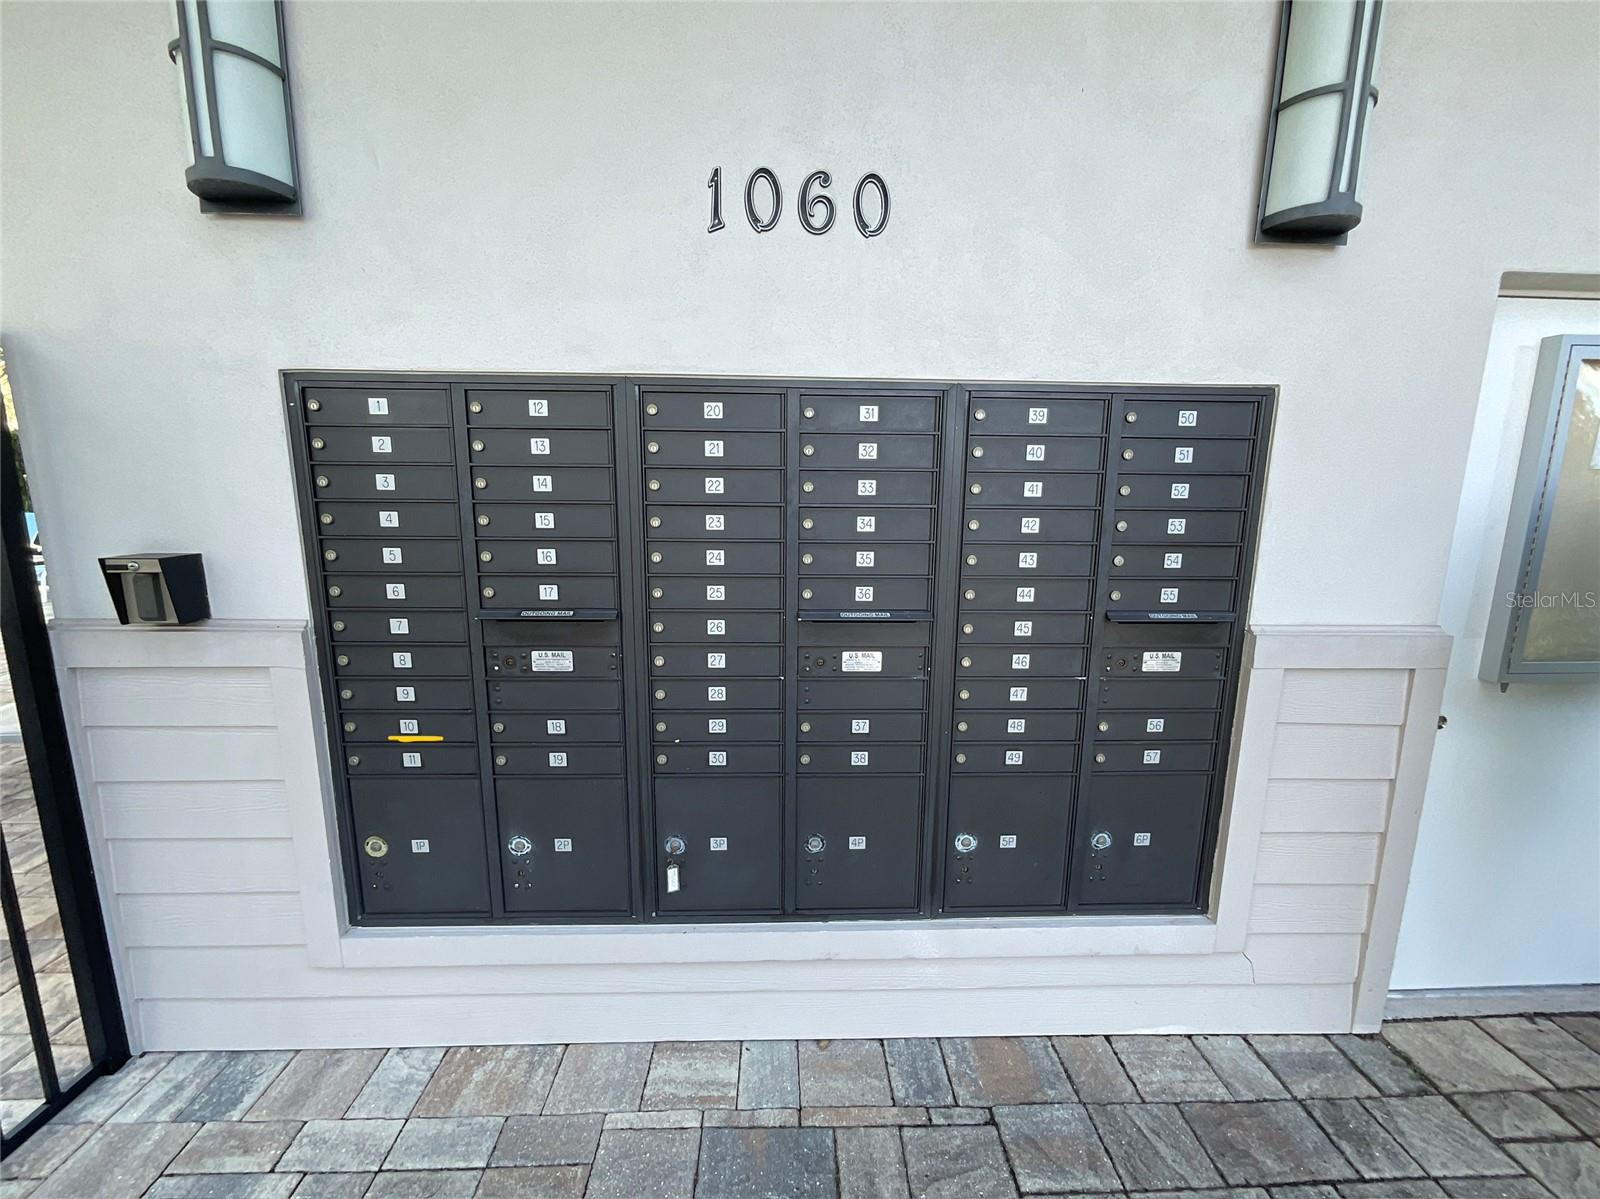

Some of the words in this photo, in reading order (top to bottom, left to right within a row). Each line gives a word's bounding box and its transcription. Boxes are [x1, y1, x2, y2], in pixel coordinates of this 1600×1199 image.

[708, 166, 891, 238] 1060
[533, 401, 544, 415] 12
[706, 404, 721, 417] 20
[863, 407, 875, 420] 31
[1031, 409, 1045, 422] 39
[1180, 412, 1195, 425] 50
[535, 440, 546, 453] 13
[709, 442, 720, 455] 21
[860, 444, 875, 458] 32
[1028, 446, 1043, 459] 40
[1178, 449, 1190, 462] 51
[537, 477, 548, 489] 14
[707, 479, 721, 492] 22
[860, 481, 874, 494] 33
[1027, 483, 1039, 495] 41
[1173, 485, 1187, 497] 52
[539, 514, 551, 527] 15
[708, 516, 722, 529] 23
[859, 518, 873, 530] 34
[1023, 519, 1037, 531] 42
[1169, 520, 1183, 532] 53
[541, 550, 553, 563] 16
[708, 551, 722, 564] 24
[858, 553, 872, 565] 35
[1021, 554, 1035, 566] 43
[1166, 555, 1179, 567] 54
[543, 586, 554, 597] 17
[709, 587, 723, 599] 25
[857, 588, 871, 600] 36
[1018, 589, 1032, 600] 44
[1162, 590, 1176, 601] 55
[709, 621, 723, 633] 26
[1016, 623, 1030, 635] 45
[710, 654, 723, 667] 27
[1014, 655, 1028, 668] 46
[710, 688, 724, 700] 28
[1012, 688, 1025, 699] 47
[403, 721, 415, 732] 10
[551, 721, 562, 732] 18
[711, 720, 724, 732] 29
[854, 721, 867, 732] 37
[1009, 720, 1023, 731] 48
[1148, 720, 1162, 731] 56
[553, 754, 564, 765] 19
[711, 753, 725, 764] 30
[853, 753, 866, 764] 38
[1007, 752, 1021, 763] 49
[1145, 751, 1159, 762] 57
[556, 840, 570, 850] 2P
[712, 839, 726, 849] 3P
[851, 838, 864, 847] 4P
[1001, 836, 1015, 847] 5P
[1135, 834, 1149, 844] 6P
[415, 841, 426, 851] 1P
